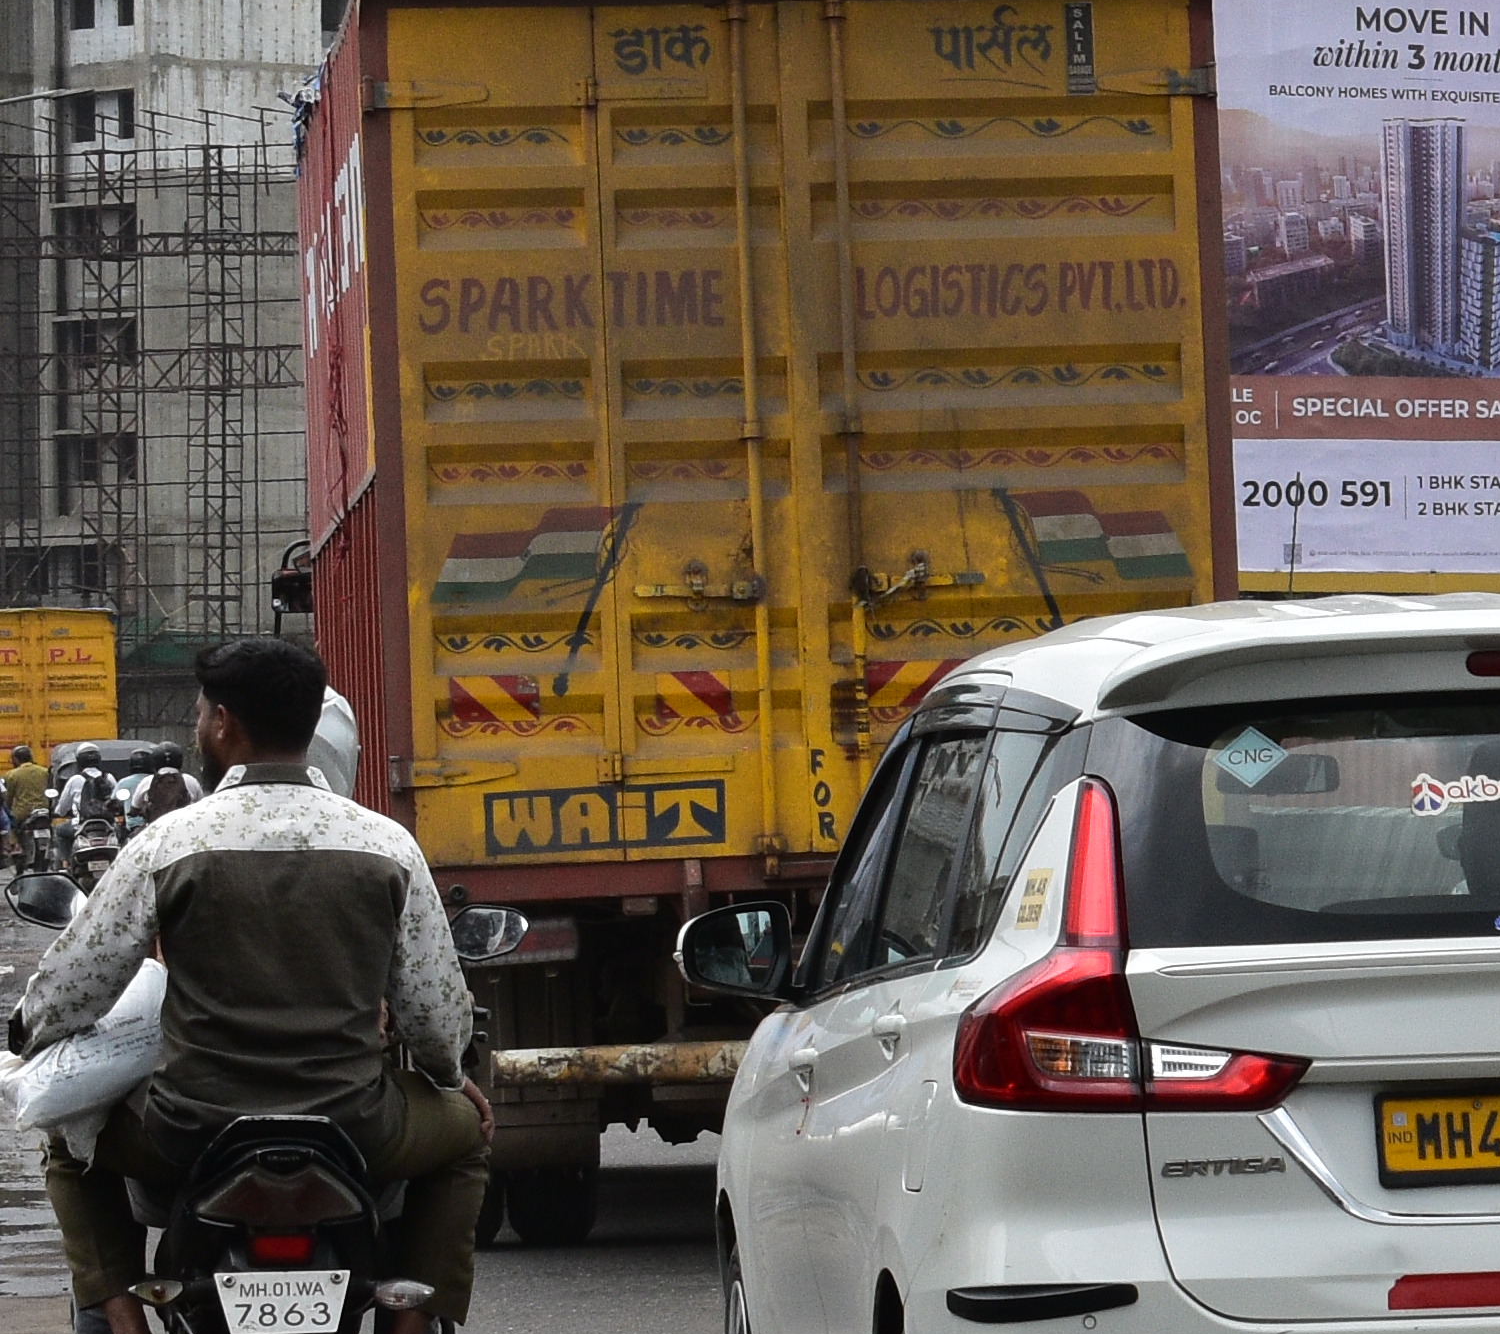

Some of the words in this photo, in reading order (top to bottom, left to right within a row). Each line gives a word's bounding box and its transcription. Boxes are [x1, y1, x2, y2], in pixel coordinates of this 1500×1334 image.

[1355, 6, 1449, 36] MOVE
[1459, 10, 1491, 37] IN
[926, 5, 1055, 76] पार्सल
[1073, 8, 1087, 64] SALIM
[608, 24, 713, 78] डाक
[1313, 38, 1399, 70] within
[1407, 44, 1426, 71] 3
[1269, 84, 1336, 100] BALCONY
[1338, 85, 1388, 101] HOMES
[1391, 86, 1428, 102] WITH
[1431, 89, 1500, 105] EXQUISITE
[418, 275, 596, 336] SPARK
[605, 269, 726, 328] TIME
[858, 262, 1049, 320] LOGISTICS
[1292, 397, 1389, 419] SPECIAL
[1395, 398, 1470, 420] OFFER
[1241, 479, 1329, 508] 2000
[1340, 479, 1392, 508] 591
[1416, 474, 1425, 490] 1
[1429, 474, 1465, 490] BHK
[1418, 502, 1428, 517] 2
[1432, 501, 1469, 517] BHK
[1228, 748, 1273, 765] CNG
[810, 749, 838, 843] FOR
[1387, 1131, 1413, 1144] IND
[1161, 1156, 1287, 1178] ERTIGA
[239, 1282, 325, 1298] MH.01.WA
[234, 1301, 331, 1327] 7863
